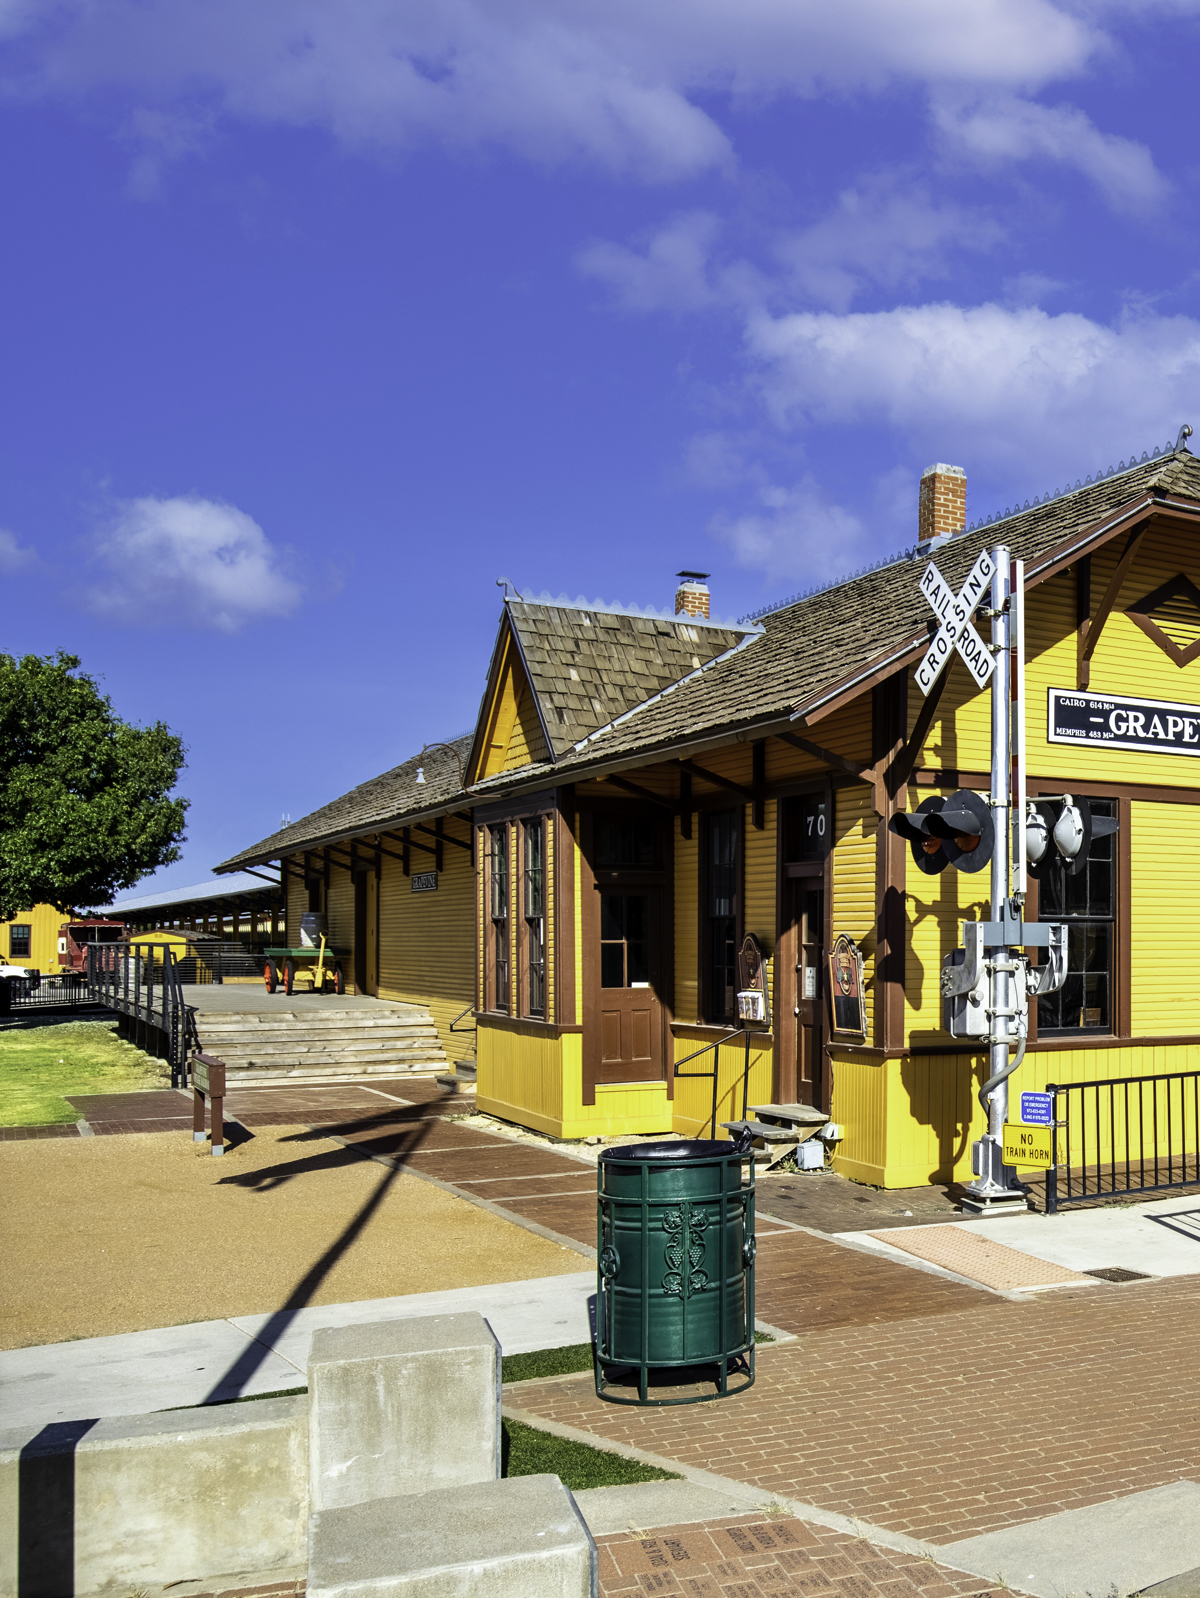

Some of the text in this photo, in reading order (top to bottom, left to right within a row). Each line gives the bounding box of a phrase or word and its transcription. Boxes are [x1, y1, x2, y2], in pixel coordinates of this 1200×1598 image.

[922, 569, 951, 620] RAIL
[920, 559, 991, 687] CROSSING
[1060, 698, 1086, 708] CAIRO
[1090, 701, 1102, 710] 614
[1056, 727, 1087, 737] MEMPHIS
[807, 814, 826, 836] 70
[1021, 1134, 1033, 1145] NO
[1006, 1147, 1049, 1160] TRAIN HORN
